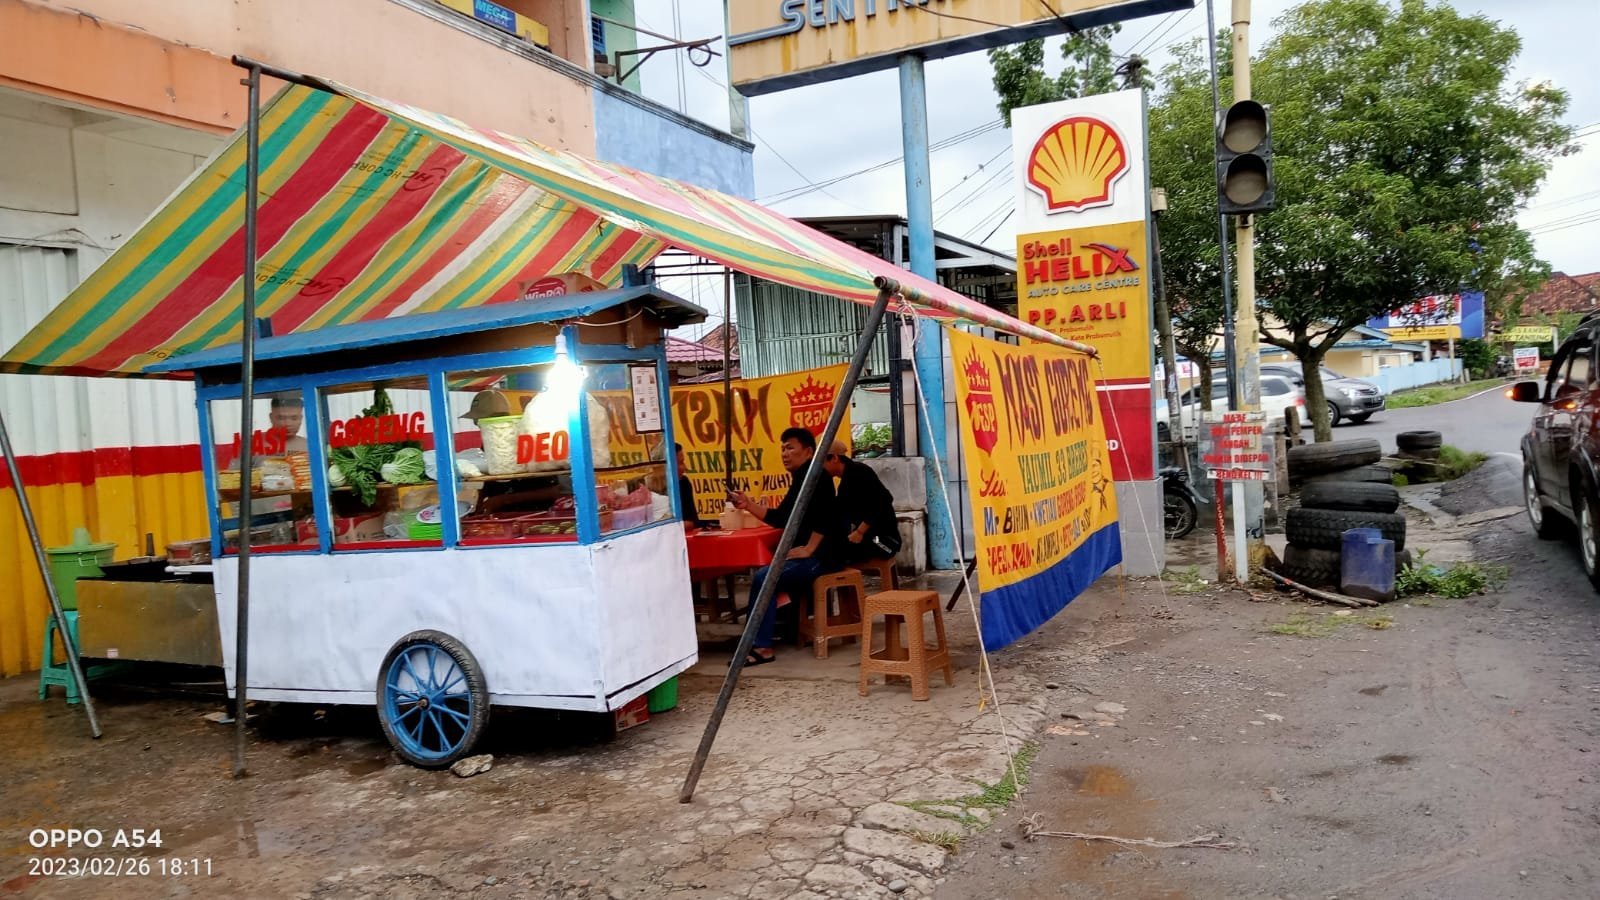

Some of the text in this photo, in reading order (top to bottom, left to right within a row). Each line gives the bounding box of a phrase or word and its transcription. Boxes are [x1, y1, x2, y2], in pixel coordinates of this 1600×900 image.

[475, 0, 508, 18] MEGA
[1023, 238, 1072, 260] Shell
[1024, 244, 1140, 284] HELIX
[1028, 277, 1140, 299] AUTO CARE CENTRE
[328, 411, 426, 449] GORENG
[516, 430, 569, 465] DEO
[1018, 451, 1056, 494] YAUMIL
